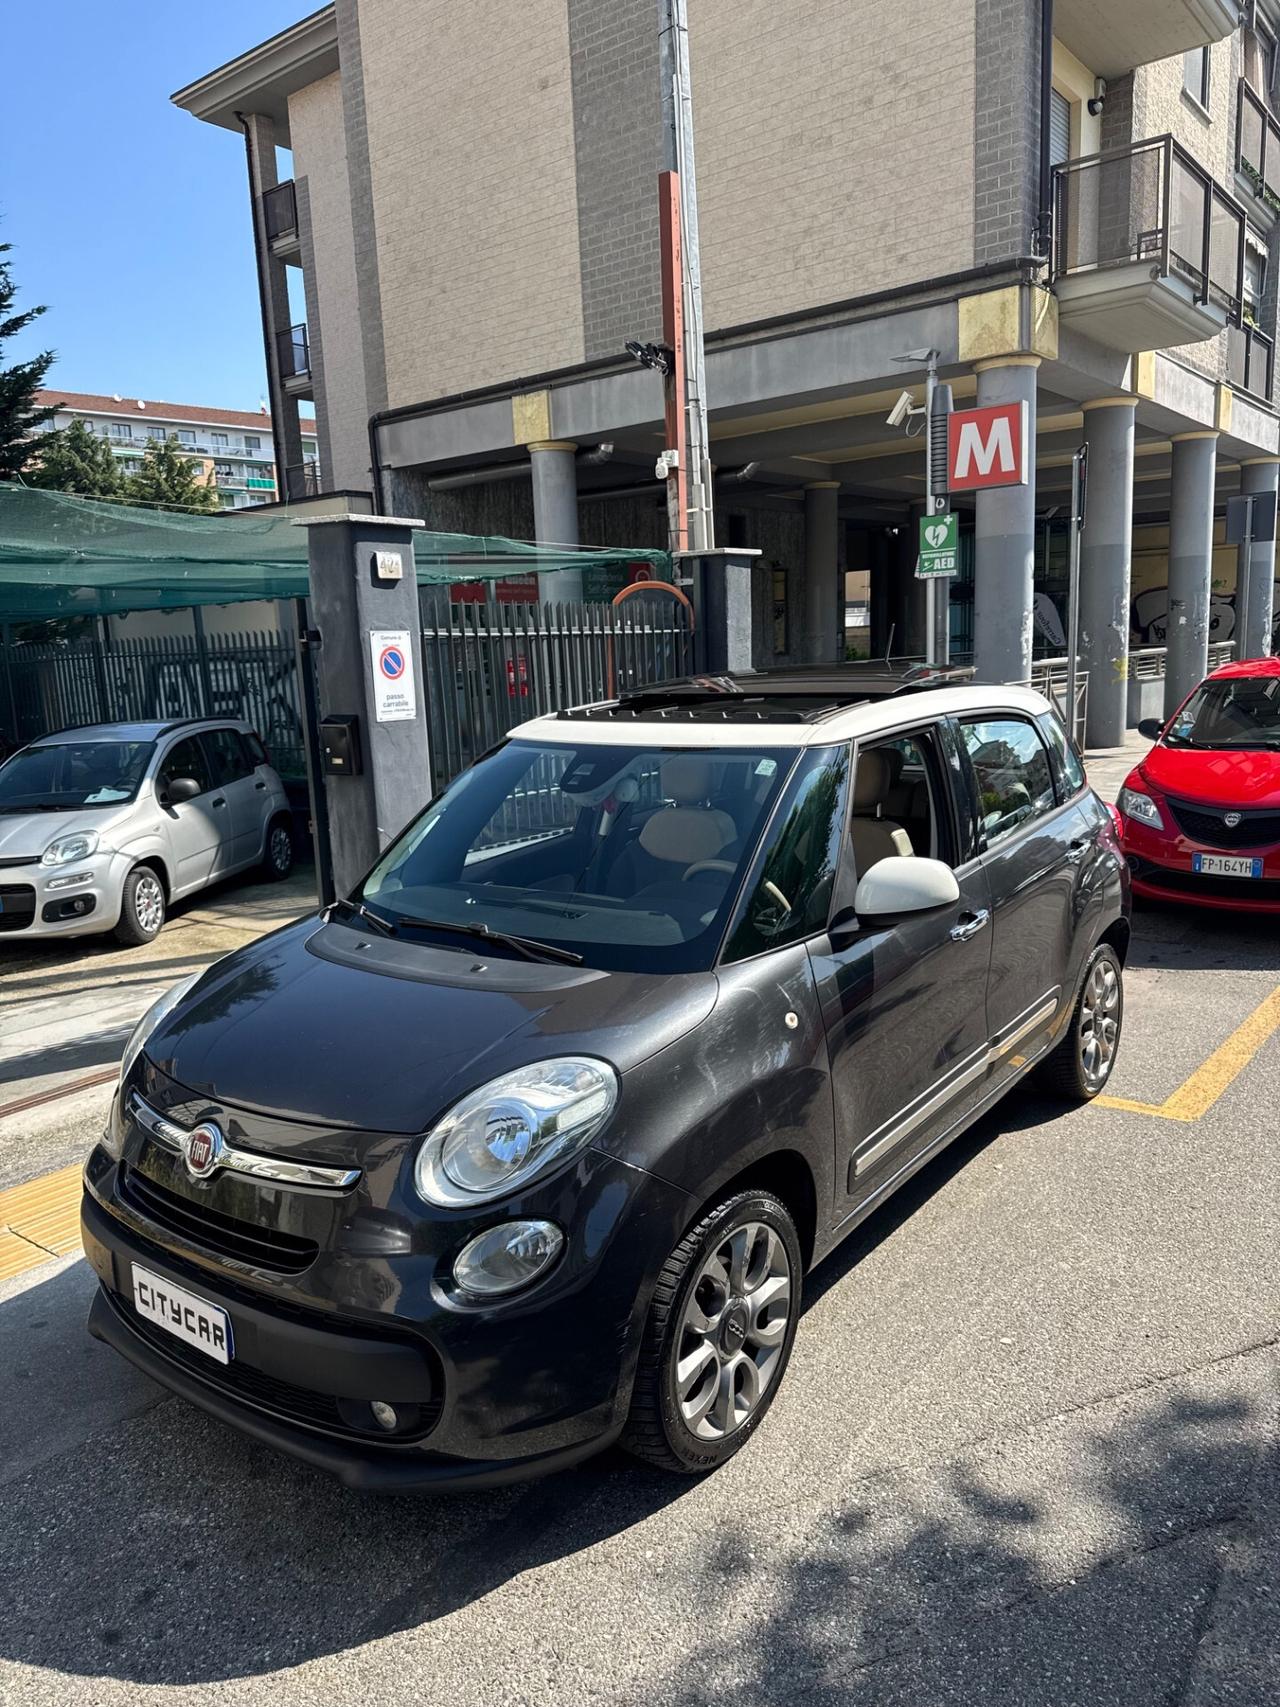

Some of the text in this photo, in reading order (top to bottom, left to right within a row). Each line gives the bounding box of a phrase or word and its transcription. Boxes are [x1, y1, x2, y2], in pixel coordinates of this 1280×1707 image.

[954, 417, 1016, 479] M
[933, 557, 955, 570] AED
[383, 700, 409, 708] carrabile
[191, 1140, 210, 1163] FIAT
[138, 1280, 226, 1351] CITYCAR
